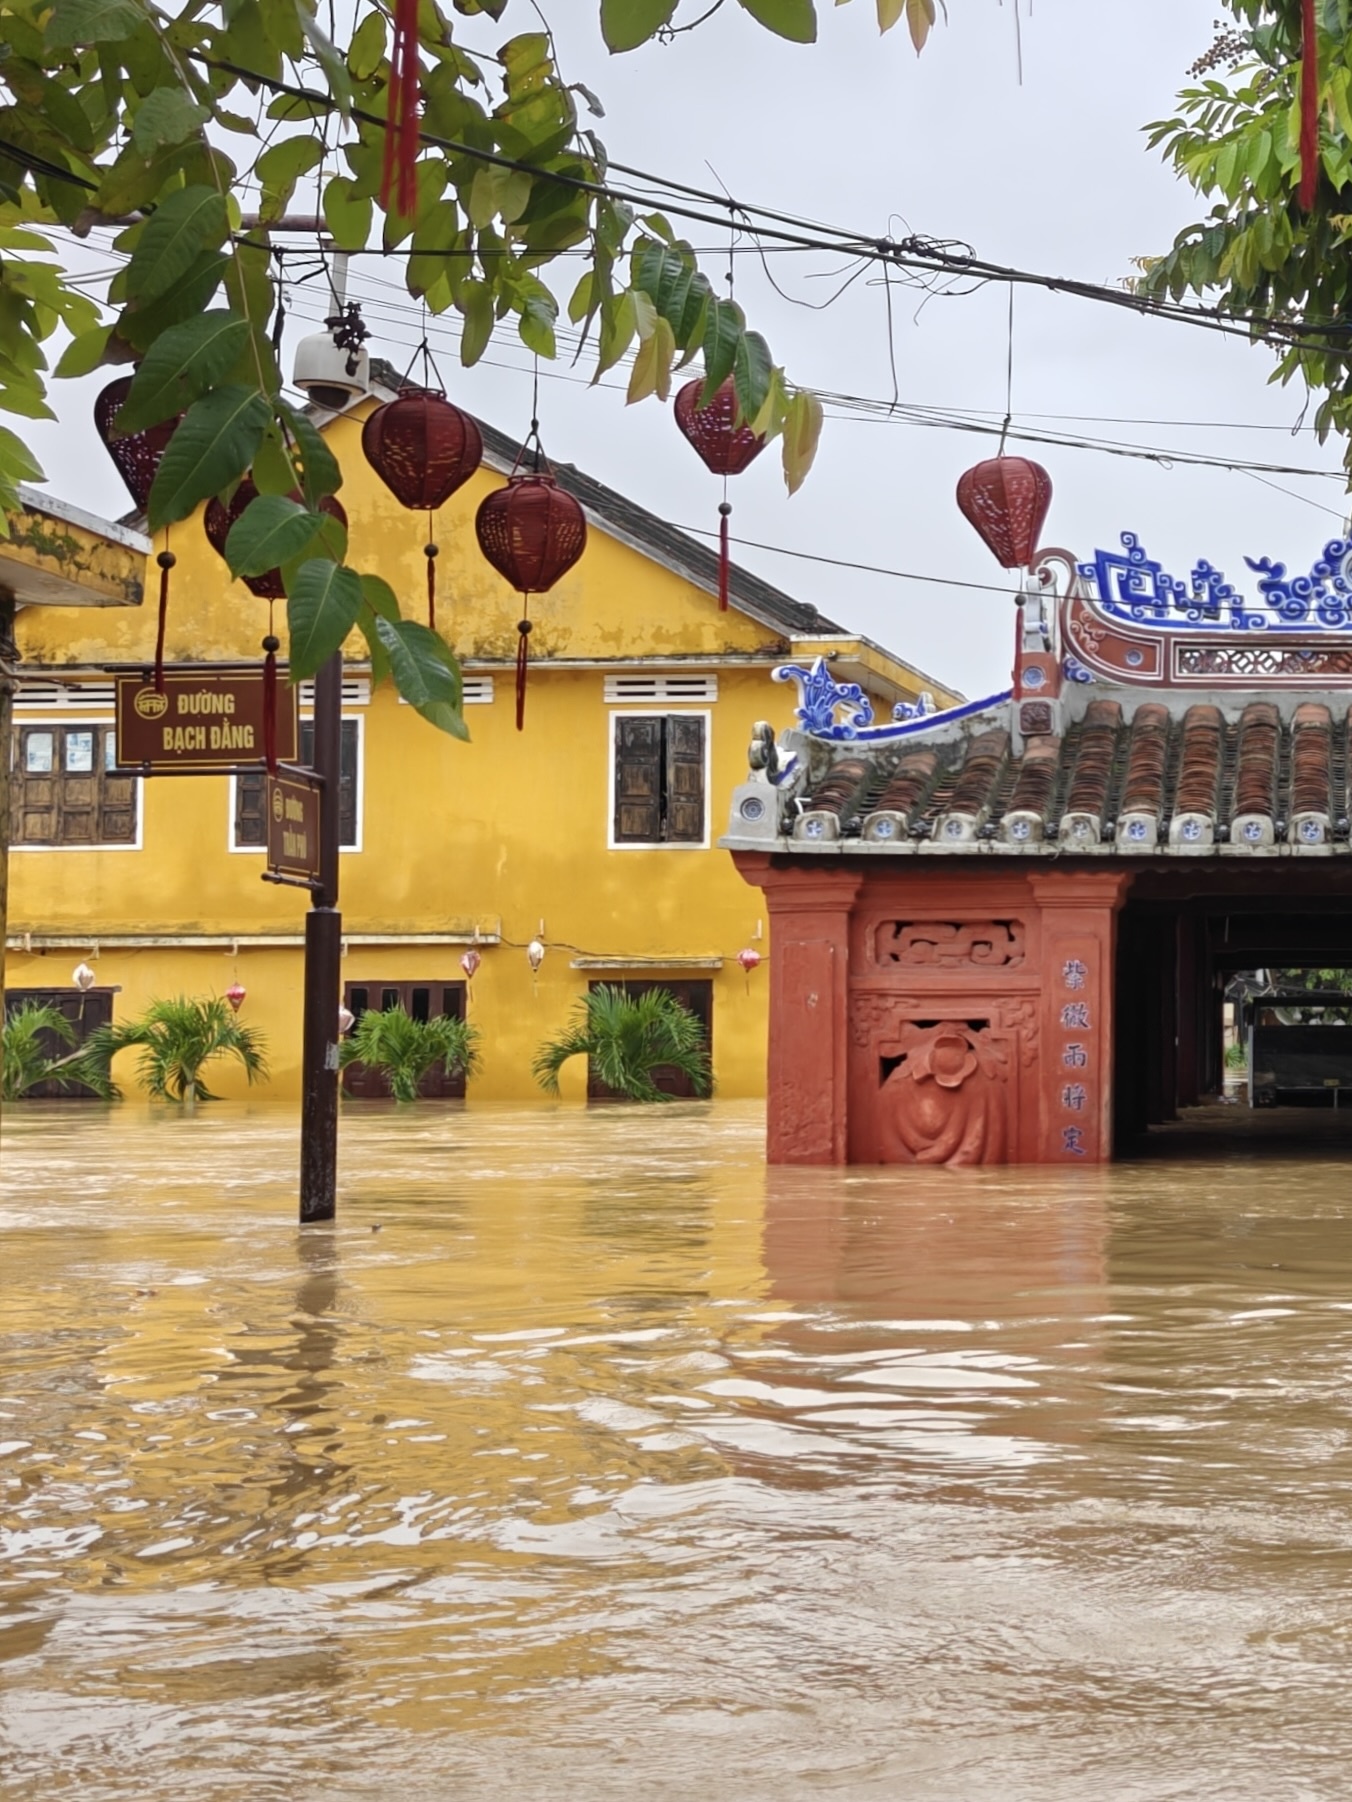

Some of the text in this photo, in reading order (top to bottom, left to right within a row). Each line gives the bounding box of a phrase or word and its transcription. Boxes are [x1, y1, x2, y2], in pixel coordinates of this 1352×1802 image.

[177, 688, 235, 714] ĐƯỜNG
[163, 717, 254, 754] BẠCH ĐẰNG
